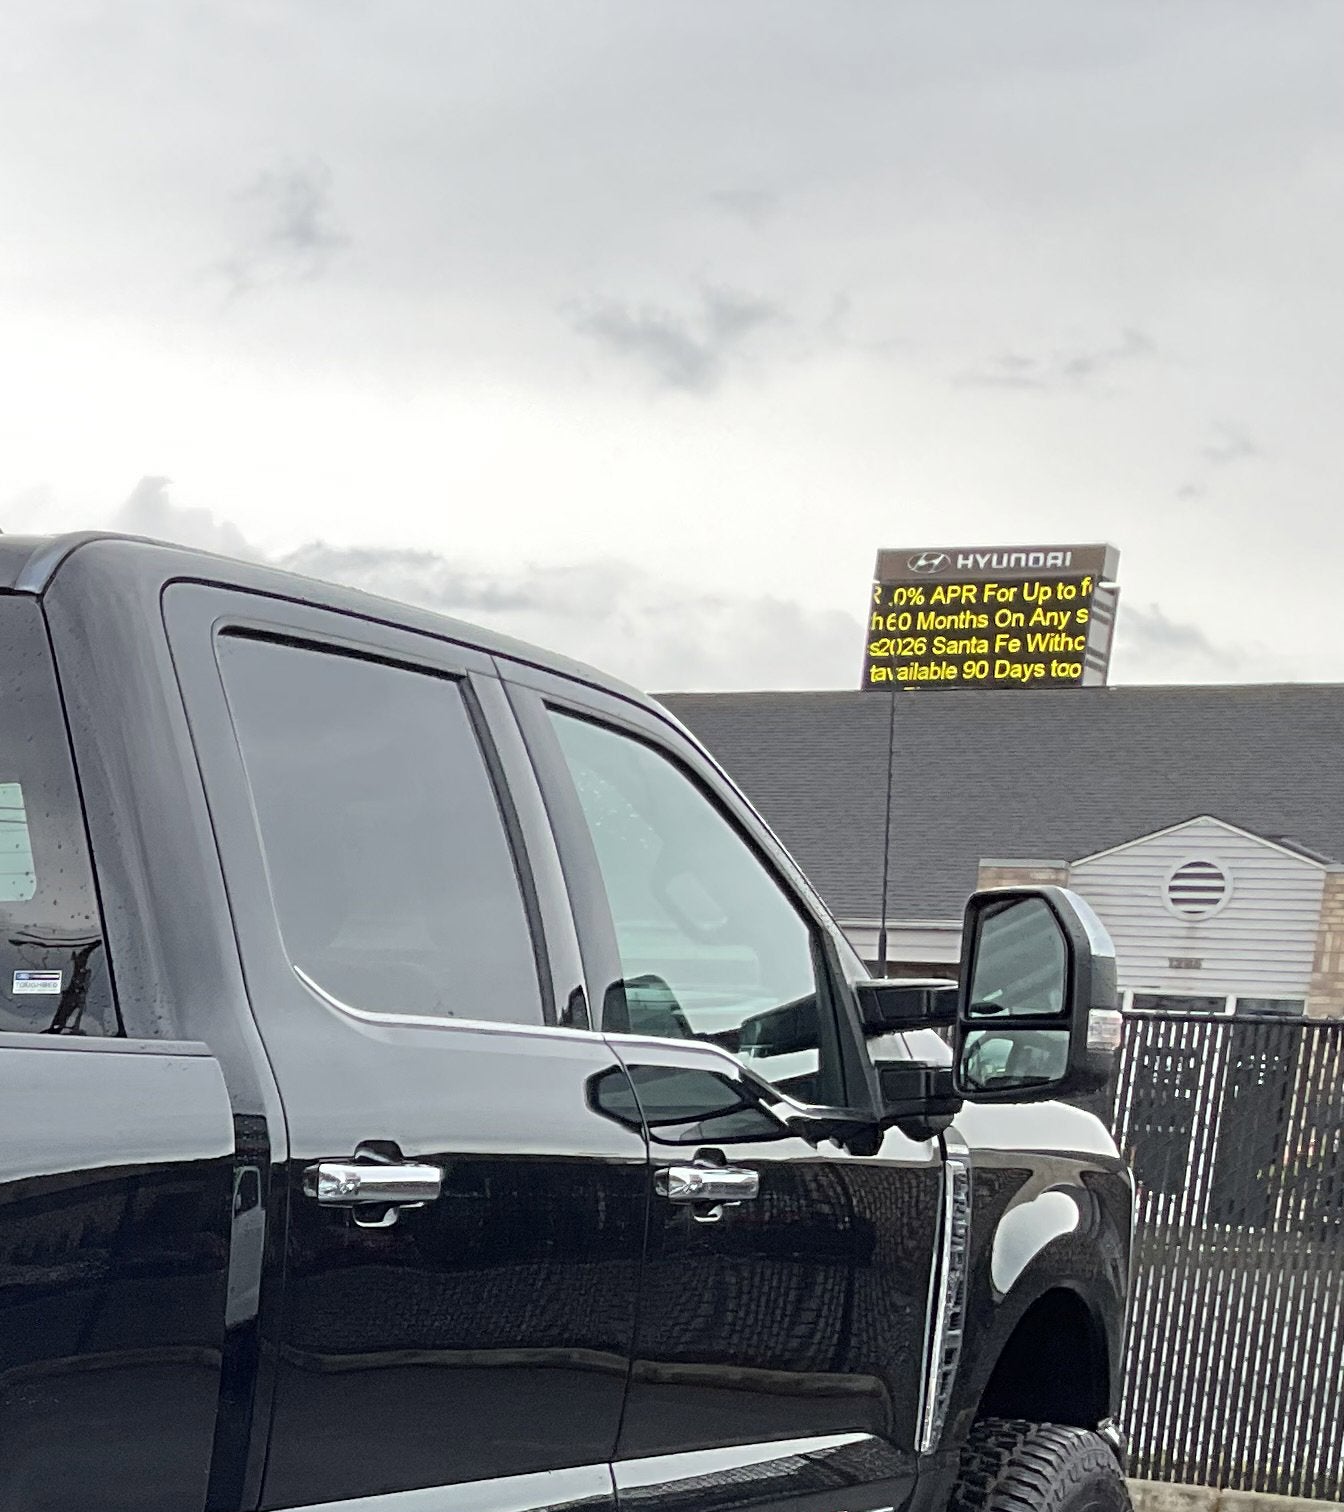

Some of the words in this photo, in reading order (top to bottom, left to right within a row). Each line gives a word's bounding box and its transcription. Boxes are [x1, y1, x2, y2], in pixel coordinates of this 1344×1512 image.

[956, 551, 1072, 570] HYUNDAI
[930, 584, 978, 605] APR
[983, 583, 1018, 603] For
[1022, 581, 1052, 605] Up
[1056, 582, 1077, 600] to
[916, 610, 989, 630] Months
[994, 608, 1025, 628] On
[1029, 607, 1072, 630] Any
[932, 636, 989, 655] Santa
[994, 634, 1021, 653] Fe
[962, 660, 989, 679] 90
[994, 659, 1046, 683] Days
